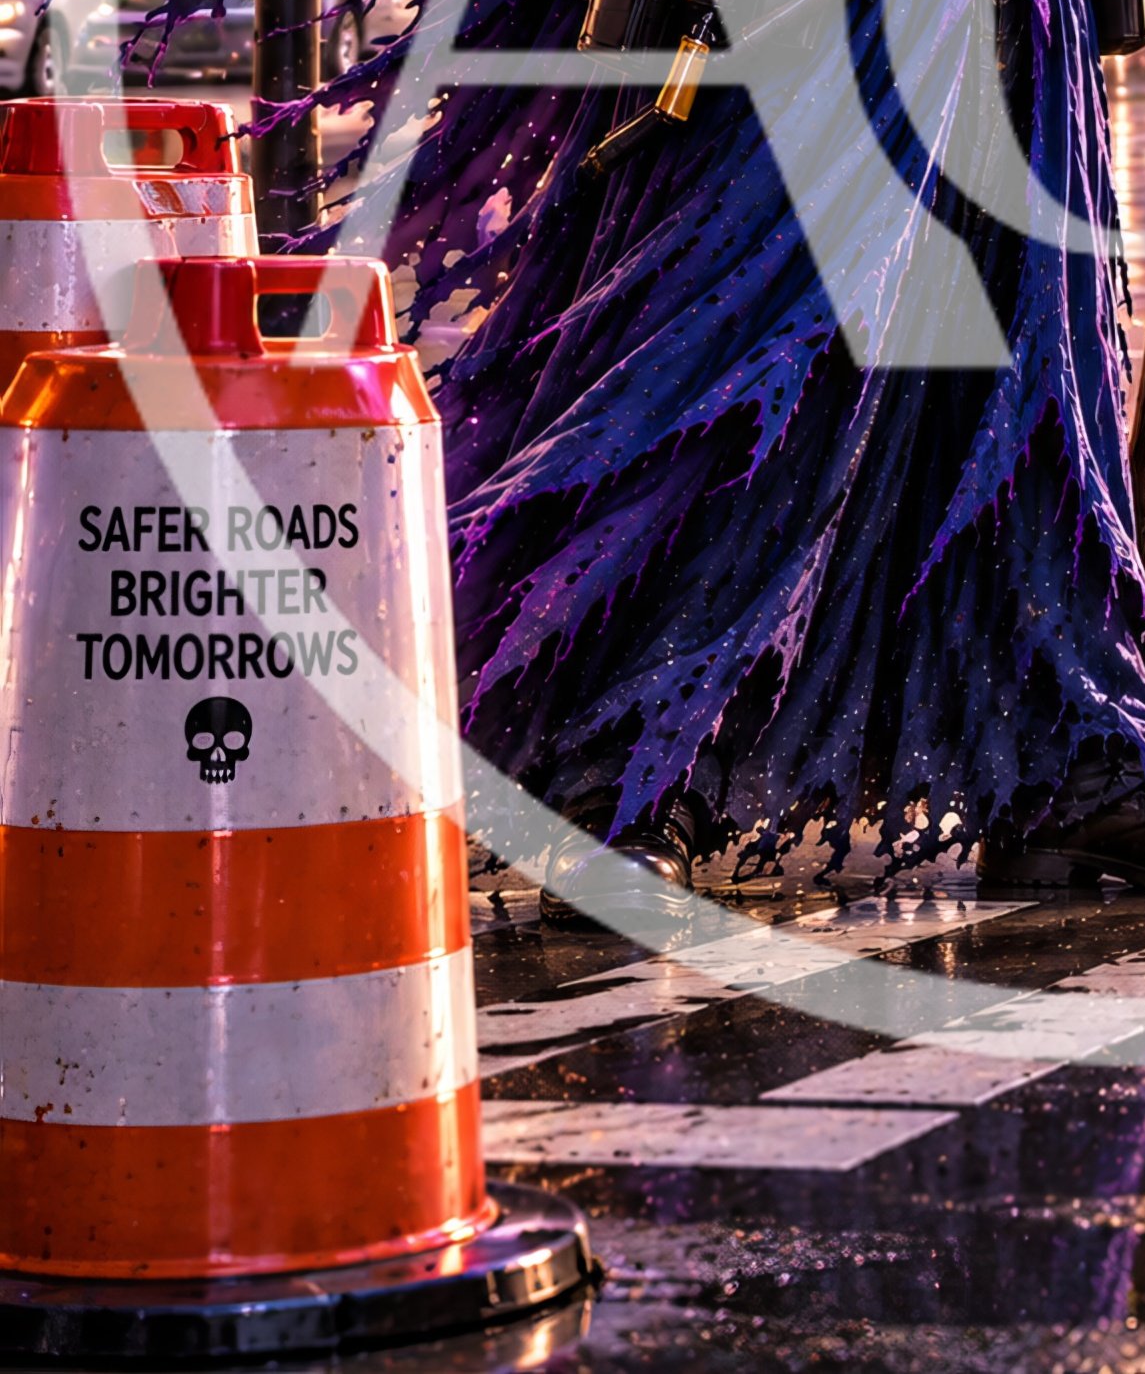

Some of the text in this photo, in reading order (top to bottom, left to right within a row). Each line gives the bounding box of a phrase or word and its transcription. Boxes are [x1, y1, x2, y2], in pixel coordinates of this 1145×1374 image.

[78, 503, 359, 552] SAFER ROADS
[110, 568, 328, 616] BRIGHTER
[76, 629, 359, 680] TOMORROWS
